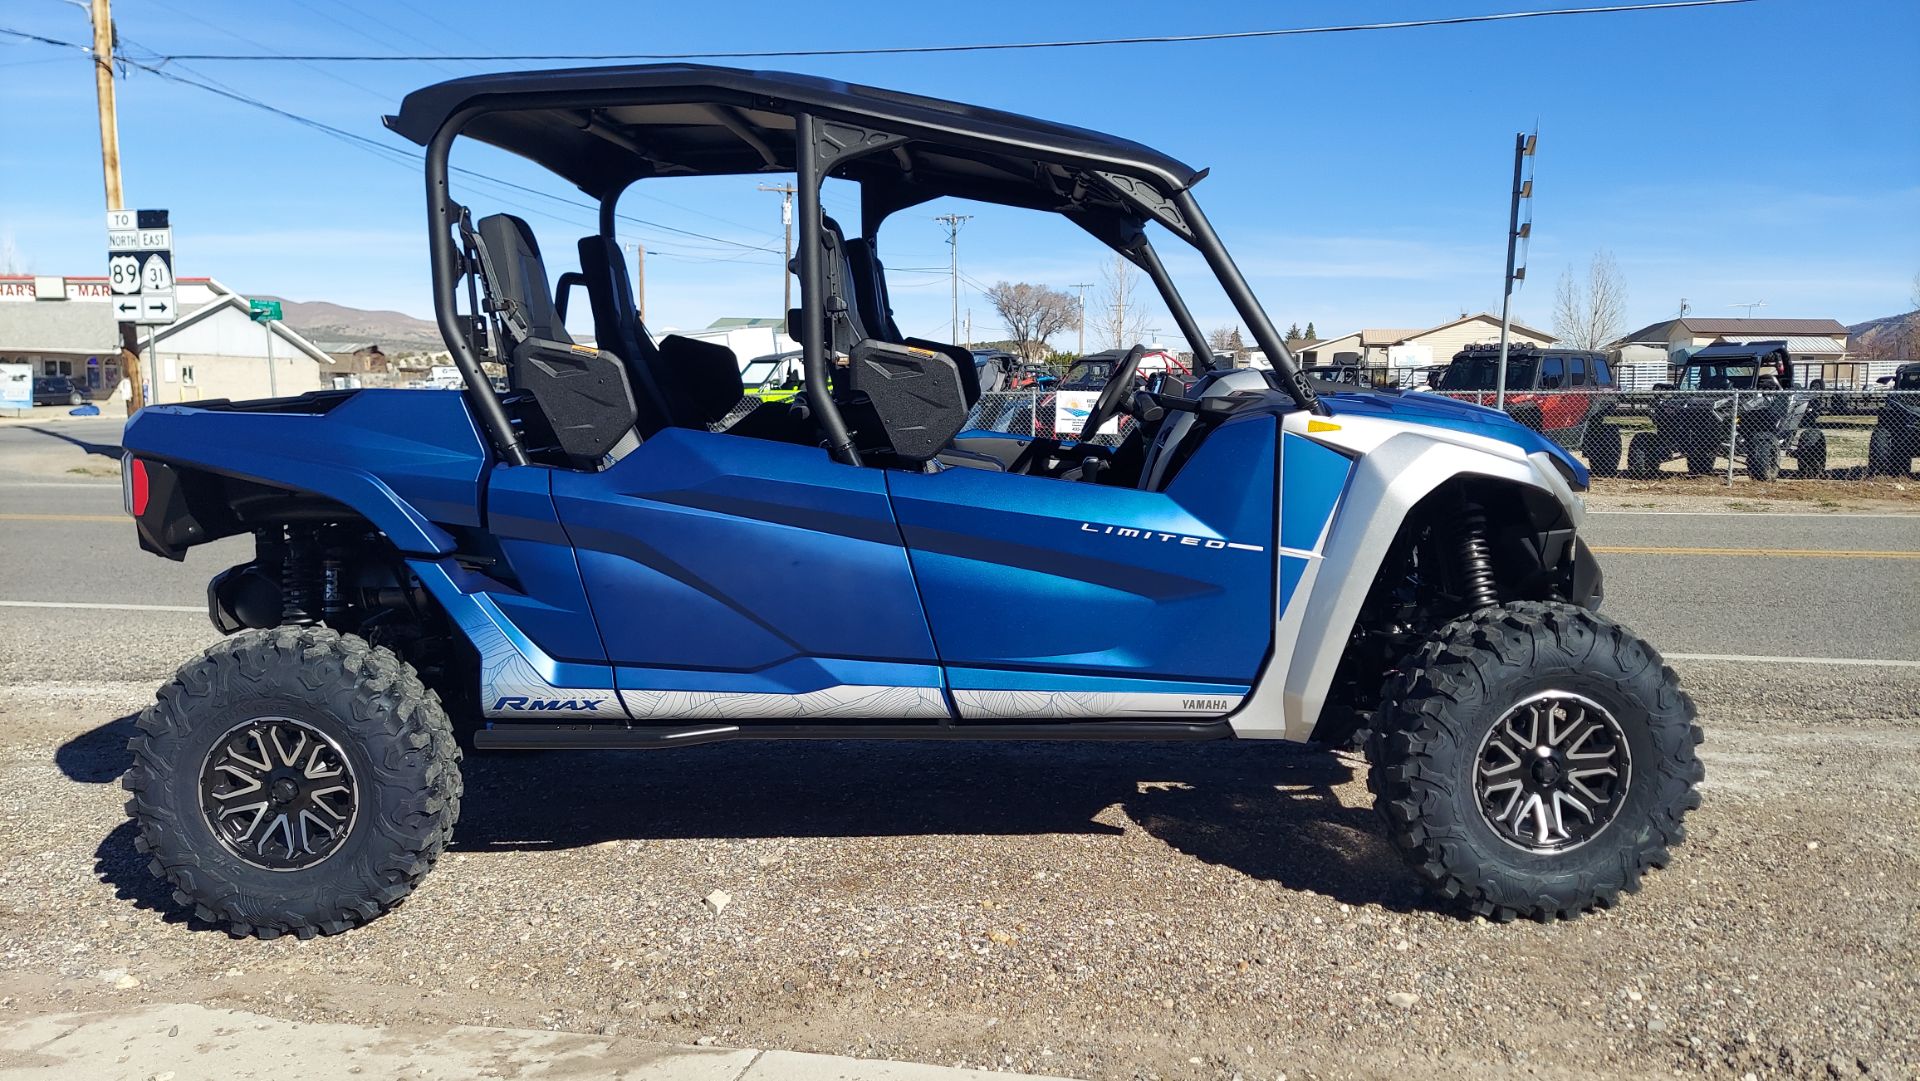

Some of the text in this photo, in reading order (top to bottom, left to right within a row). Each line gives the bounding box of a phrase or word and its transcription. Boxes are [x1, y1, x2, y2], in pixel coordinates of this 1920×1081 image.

[115, 215, 129, 225] TO
[109, 235, 136, 246] NORTH
[143, 233, 164, 246] EAST
[113, 264, 136, 283] 89
[150, 268, 162, 282] 31
[79, 284, 111, 296] MAR
[1081, 523, 1229, 549] LIMITED
[1182, 699, 1228, 710] YAMAHA
